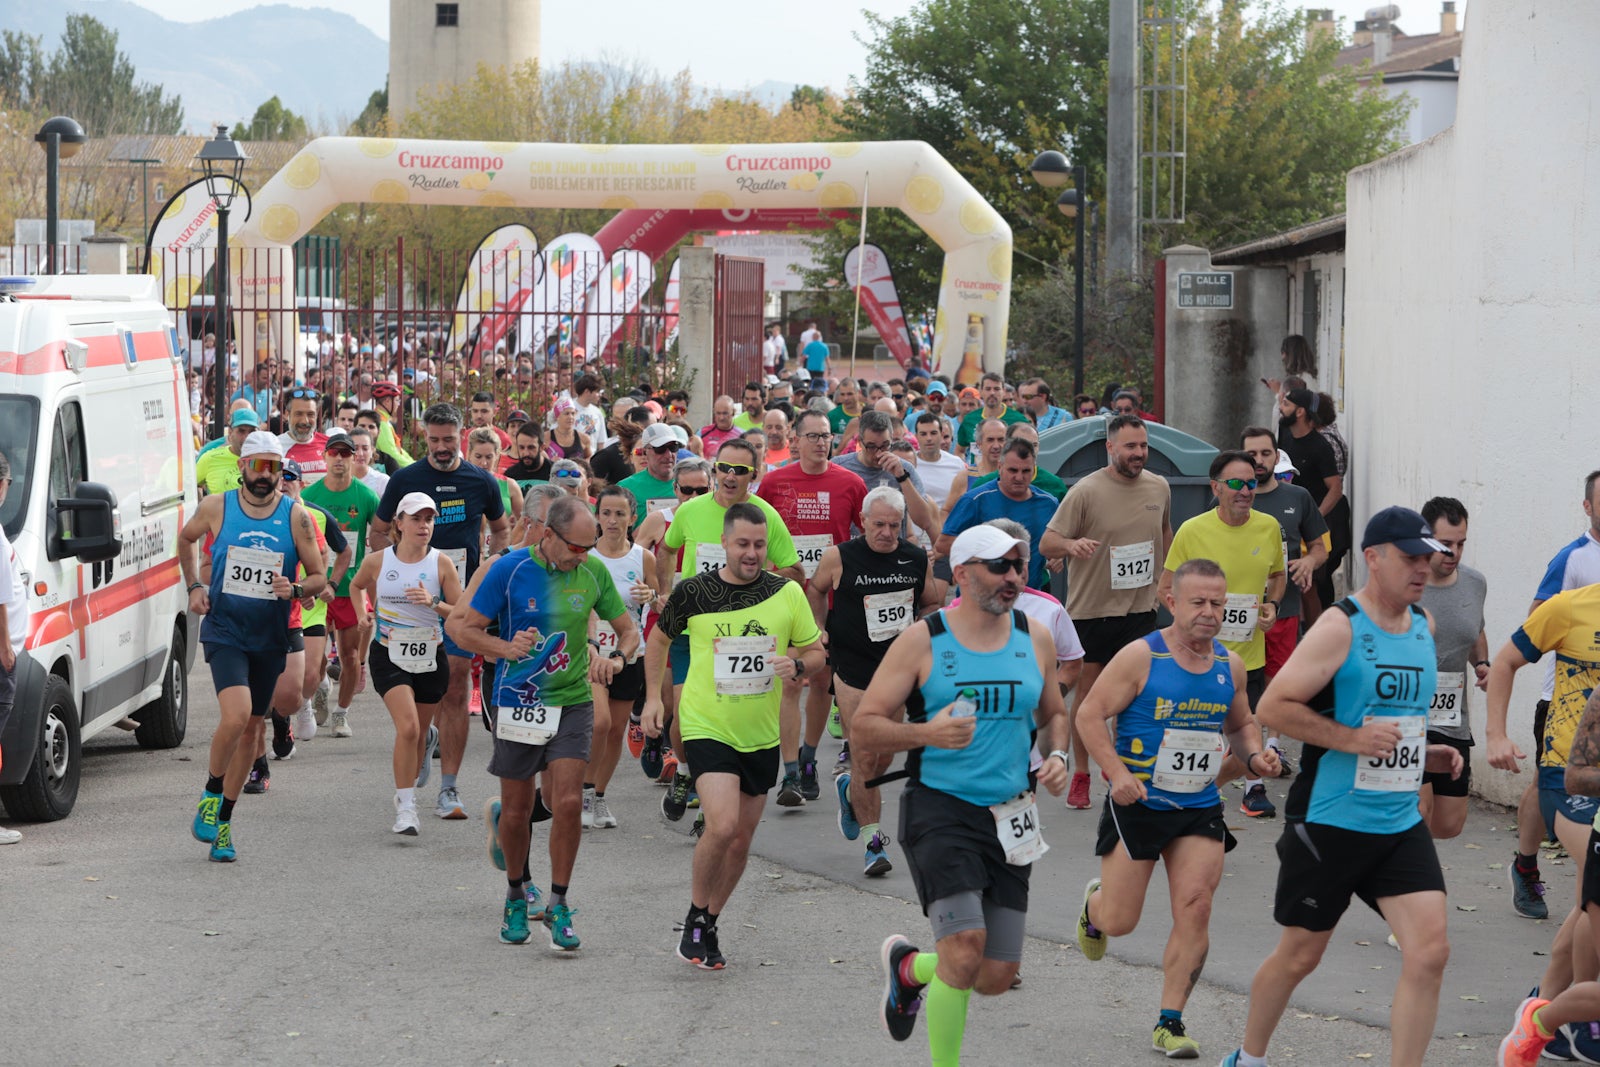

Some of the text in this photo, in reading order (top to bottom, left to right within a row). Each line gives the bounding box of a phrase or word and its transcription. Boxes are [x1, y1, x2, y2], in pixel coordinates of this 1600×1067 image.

[398, 151, 503, 172] Cruzcampo
[726, 154, 831, 173] Cruzcampo
[408, 173, 460, 191] Radler
[529, 176, 697, 191] DOBLEMENTE REFRESCANTE
[736, 176, 787, 193] Radler
[168, 198, 222, 253] Cruzcampo
[954, 278, 1004, 291] Cruzcampo
[1196, 276, 1227, 285] CALLE
[441, 505, 465, 516] PADRE
[231, 565, 274, 585] 3013
[702, 562, 727, 573] 31
[1117, 558, 1150, 577] 3127
[854, 573, 918, 586] Almuñécar
[878, 606, 905, 623] 550
[714, 623, 732, 636] XI
[400, 642, 427, 657] 768
[728, 655, 764, 673] 726
[512, 706, 547, 724] 863
[1175, 711, 1209, 719] deportes
[1178, 698, 1228, 715] olimpo
[1172, 751, 1210, 772] 314
